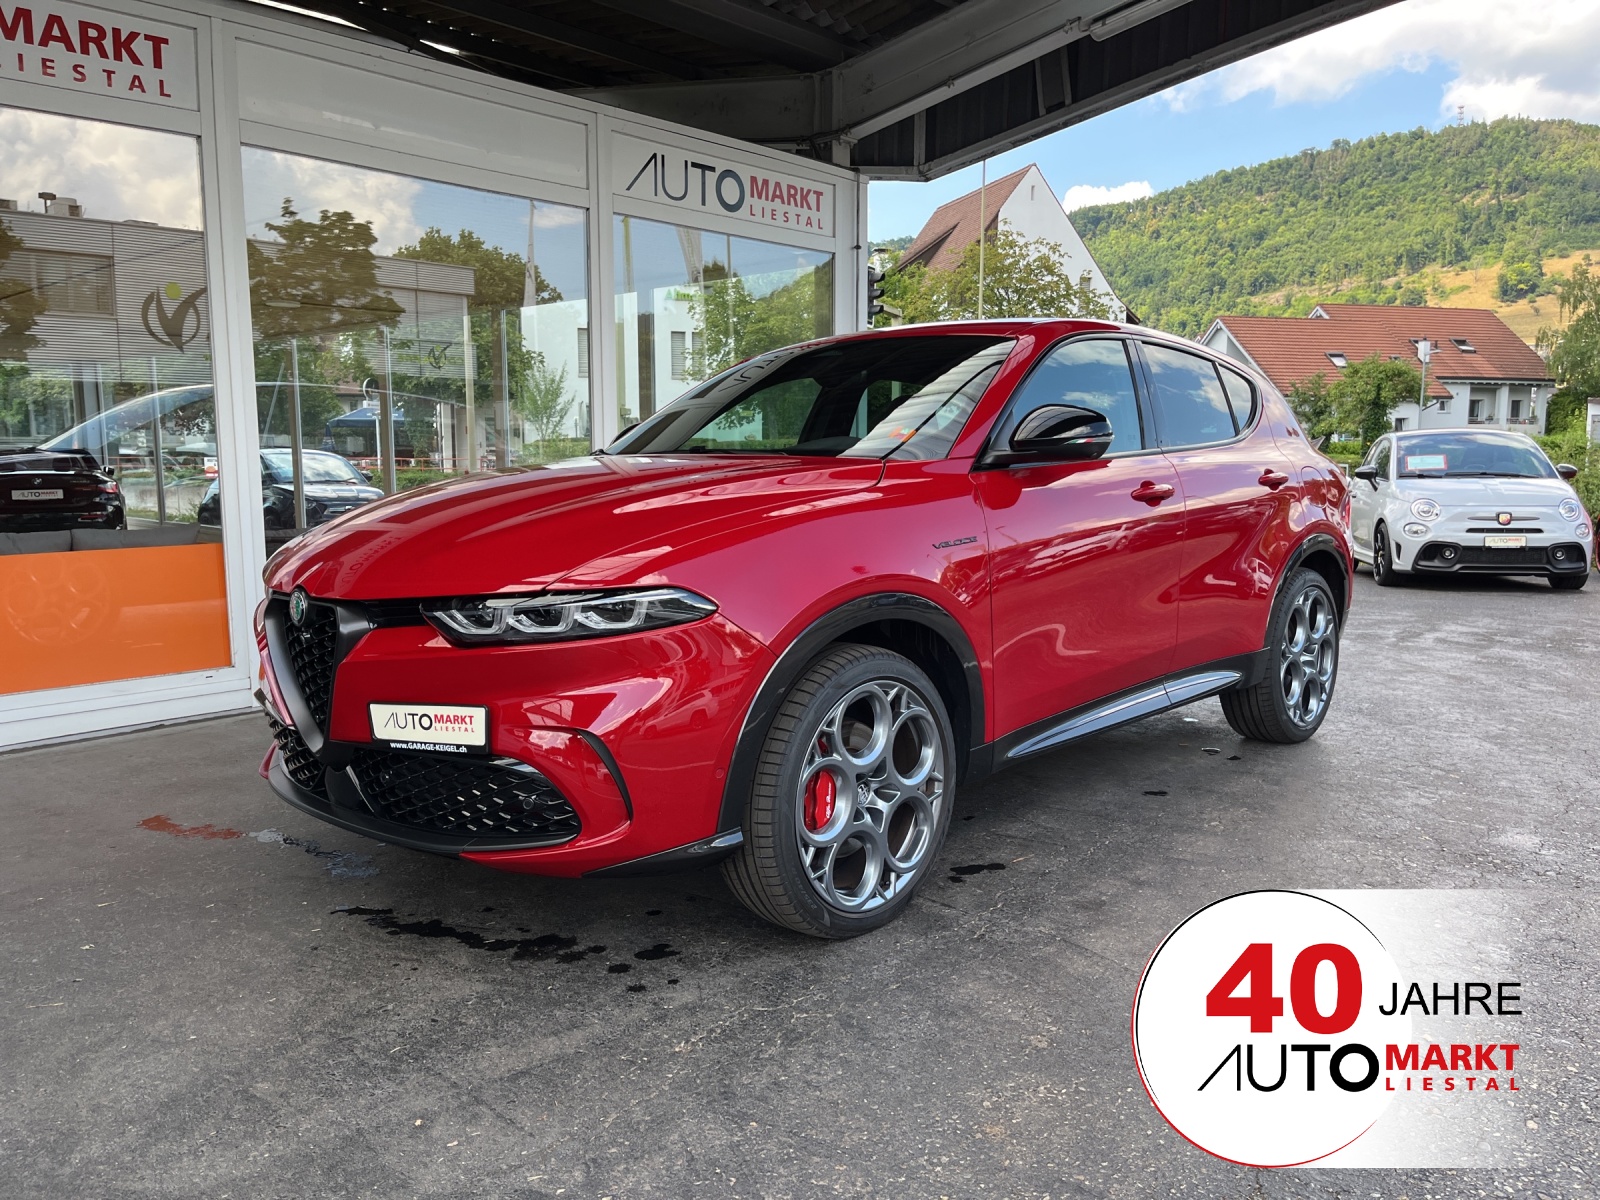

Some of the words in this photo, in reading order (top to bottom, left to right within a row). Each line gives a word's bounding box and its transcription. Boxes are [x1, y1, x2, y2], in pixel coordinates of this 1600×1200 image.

[0, 5, 170, 70] MARKT
[0, 53, 172, 98] IESTAL
[749, 204, 824, 230] LIESTAL
[434, 725, 475, 733] LIESTAL
[389, 741, 468, 753] www.GARAGE-KEIGEL.ch
